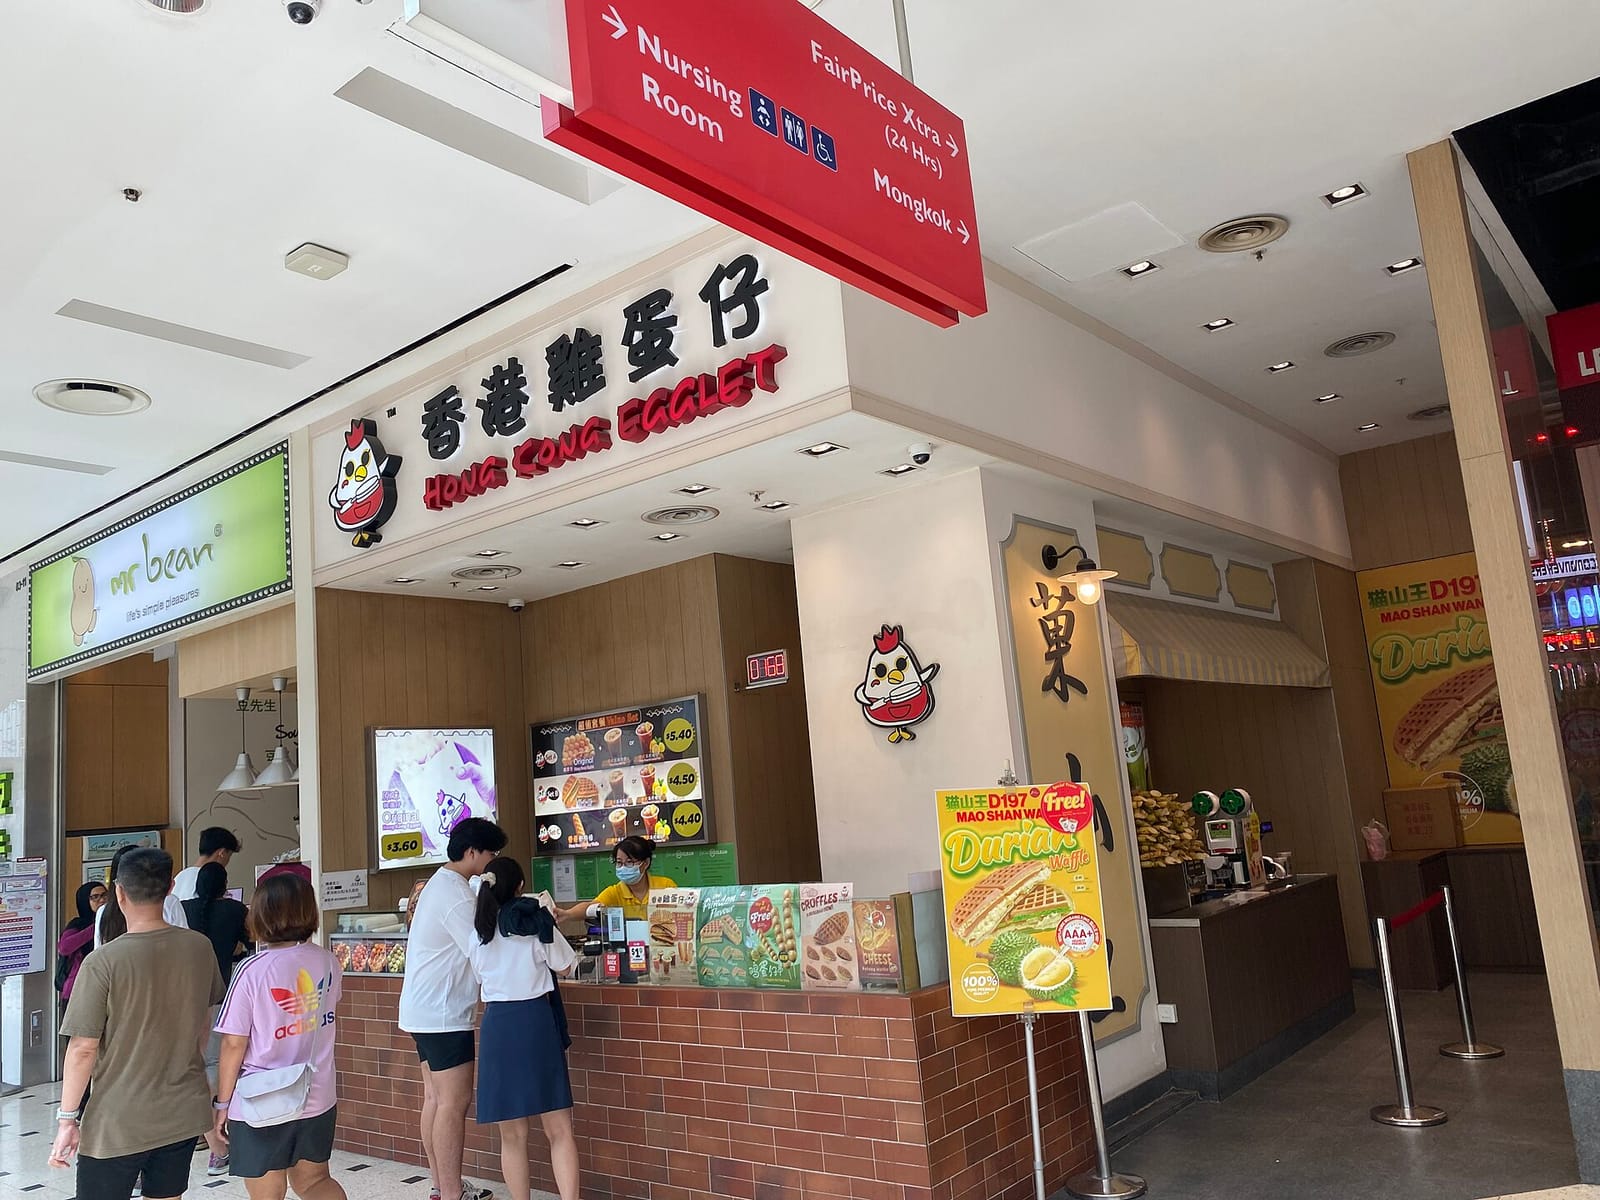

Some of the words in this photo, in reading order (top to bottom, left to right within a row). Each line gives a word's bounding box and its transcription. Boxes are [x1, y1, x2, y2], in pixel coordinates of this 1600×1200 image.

[637, 25, 744, 118] Nursing
[810, 40, 898, 116] FairPrice
[900, 102, 941, 147] Xtra
[641, 73, 724, 143] Room
[885, 124, 908, 154] (24
[912, 138, 943, 180] Hrs)
[873, 168, 952, 234] Mongkok
[421, 254, 769, 460] 香港雞蛋仔
[423, 455, 509, 511] HONG
[512, 416, 613, 479] KONG
[616, 344, 788, 444] EGGLET
[110, 563, 139, 596] mr
[141, 533, 214, 583] bean
[126, 608, 141, 623] life's
[142, 600, 165, 616] simple
[165, 588, 200, 611] pleasures
[1380, 609, 1411, 623] MAO
[1412, 603, 1451, 618] SHAN
[1453, 598, 1485, 612] WAN
[1372, 616, 1491, 680] Duria
[236, 699, 277, 712] 豆先生
[666, 728, 692, 742] $5.40
[573, 757, 594, 766] Original
[669, 773, 695, 786] $4.50
[1043, 790, 1086, 812] Free!
[382, 809, 419, 824] Original
[674, 812, 701, 825] $4.40
[956, 811, 986, 823] MAO
[986, 809, 1023, 822] SHAN
[1024, 808, 1043, 820] WA
[387, 840, 418, 852] $3.60
[945, 819, 1077, 874] Durian
[1049, 848, 1090, 873] Waffle
[801, 892, 838, 912] CROFFLES
[750, 911, 771, 924] Free
[1064, 928, 1093, 939] AAA+
[863, 952, 892, 966] CHEESE
[963, 975, 998, 988] 100%
